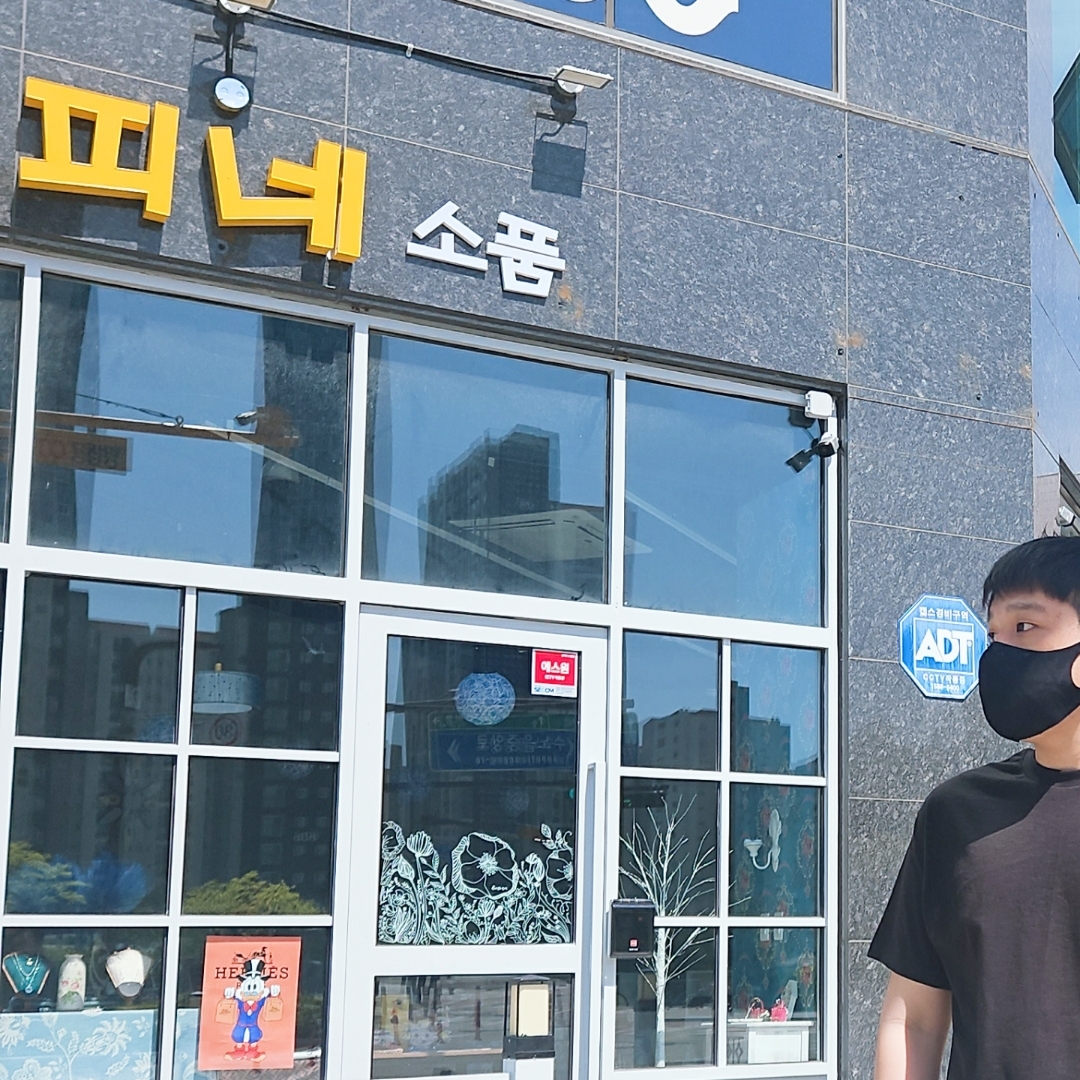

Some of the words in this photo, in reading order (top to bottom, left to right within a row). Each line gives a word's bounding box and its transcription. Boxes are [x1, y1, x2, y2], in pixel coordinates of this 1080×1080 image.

[18, 76, 368, 263] 피네
[405, 200, 566, 298] 소품
[915, 628, 973, 666] ADT
[540, 660, 570, 675] 에스원
[215, 965, 289, 979] HEÈS
